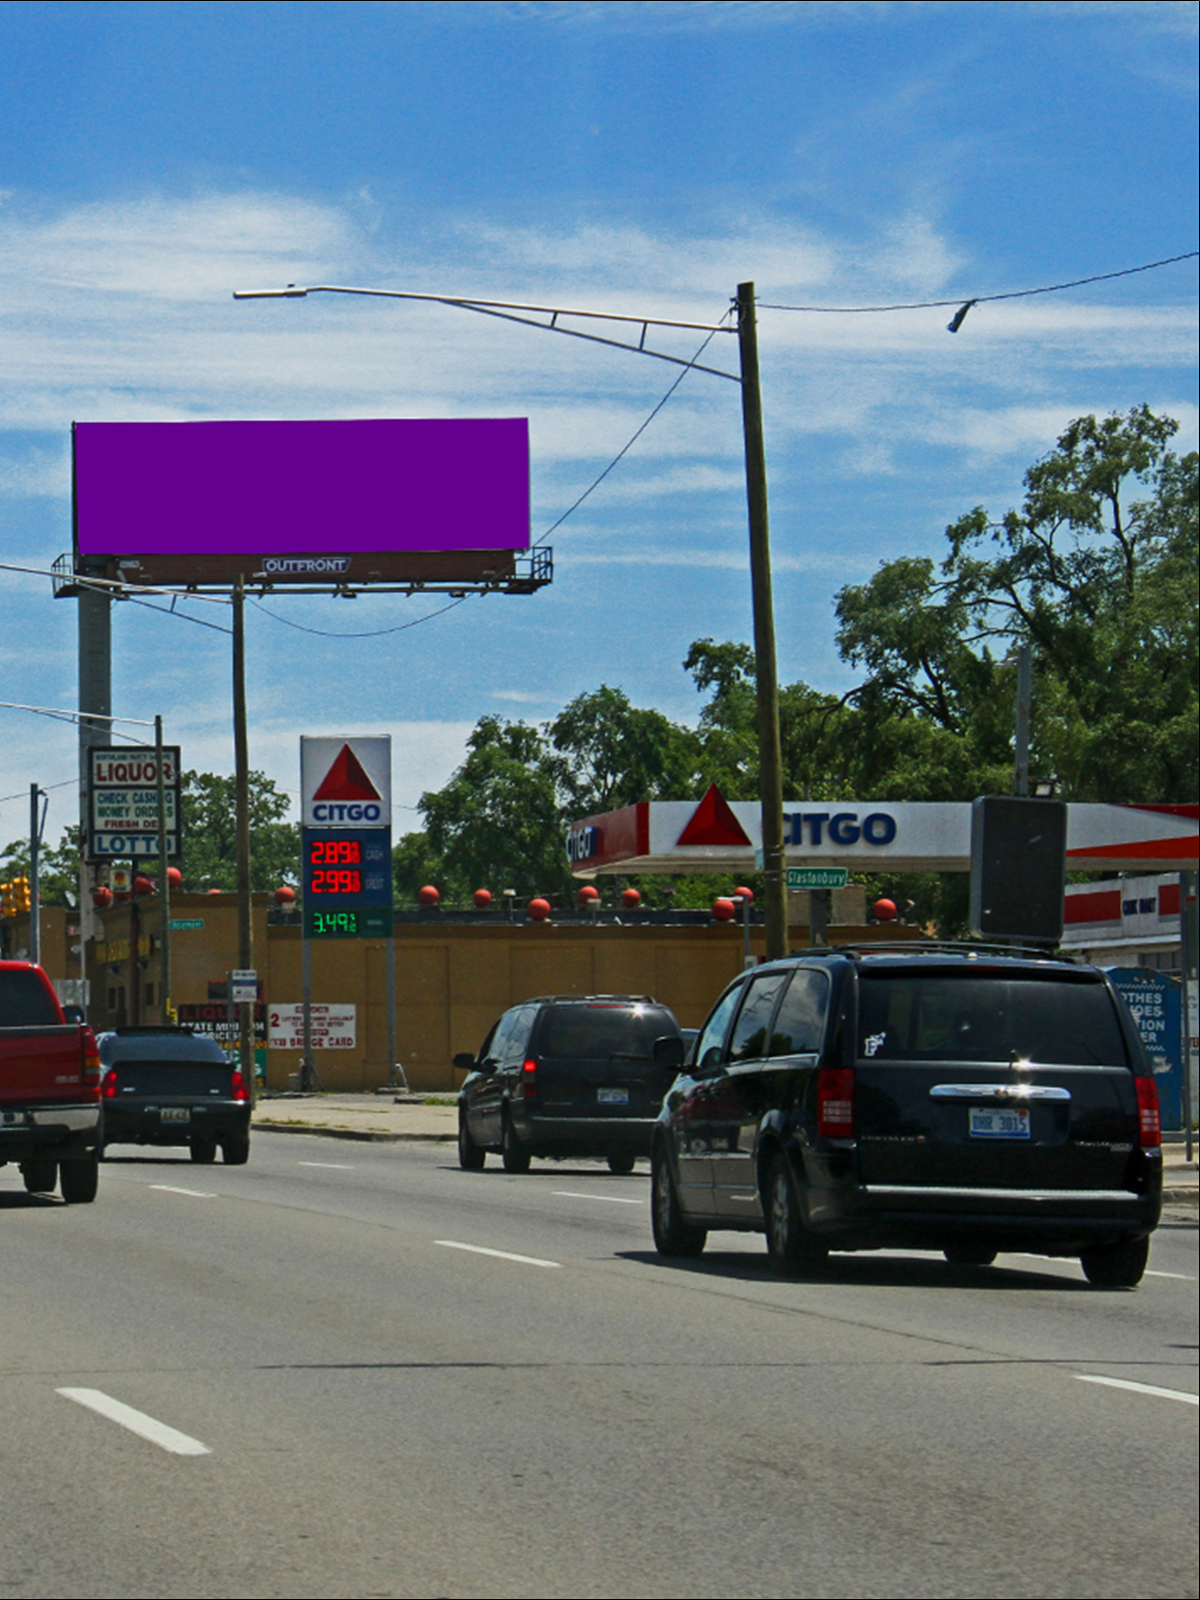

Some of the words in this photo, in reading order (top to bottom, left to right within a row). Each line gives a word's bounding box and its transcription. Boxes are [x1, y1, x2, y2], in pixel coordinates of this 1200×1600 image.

[266, 559, 346, 572] OUTFRONT
[96, 762, 172, 782] LIQUOR
[97, 792, 128, 804] CHECK
[132, 792, 173, 804] CASHG
[97, 806, 131, 818] MONEY
[134, 806, 173, 818] ORDES
[312, 803, 382, 822] CITGO
[104, 819, 139, 828] FRESH
[143, 819, 158, 828] DE
[96, 836, 173, 854] LOTTO
[1121, 992, 1162, 1005] THES
[270, 1012, 281, 1028] 2
[289, 1037, 324, 1047] BRGE
[328, 1037, 354, 1047] CARD
[998, 1116, 1027, 1132] 3015
